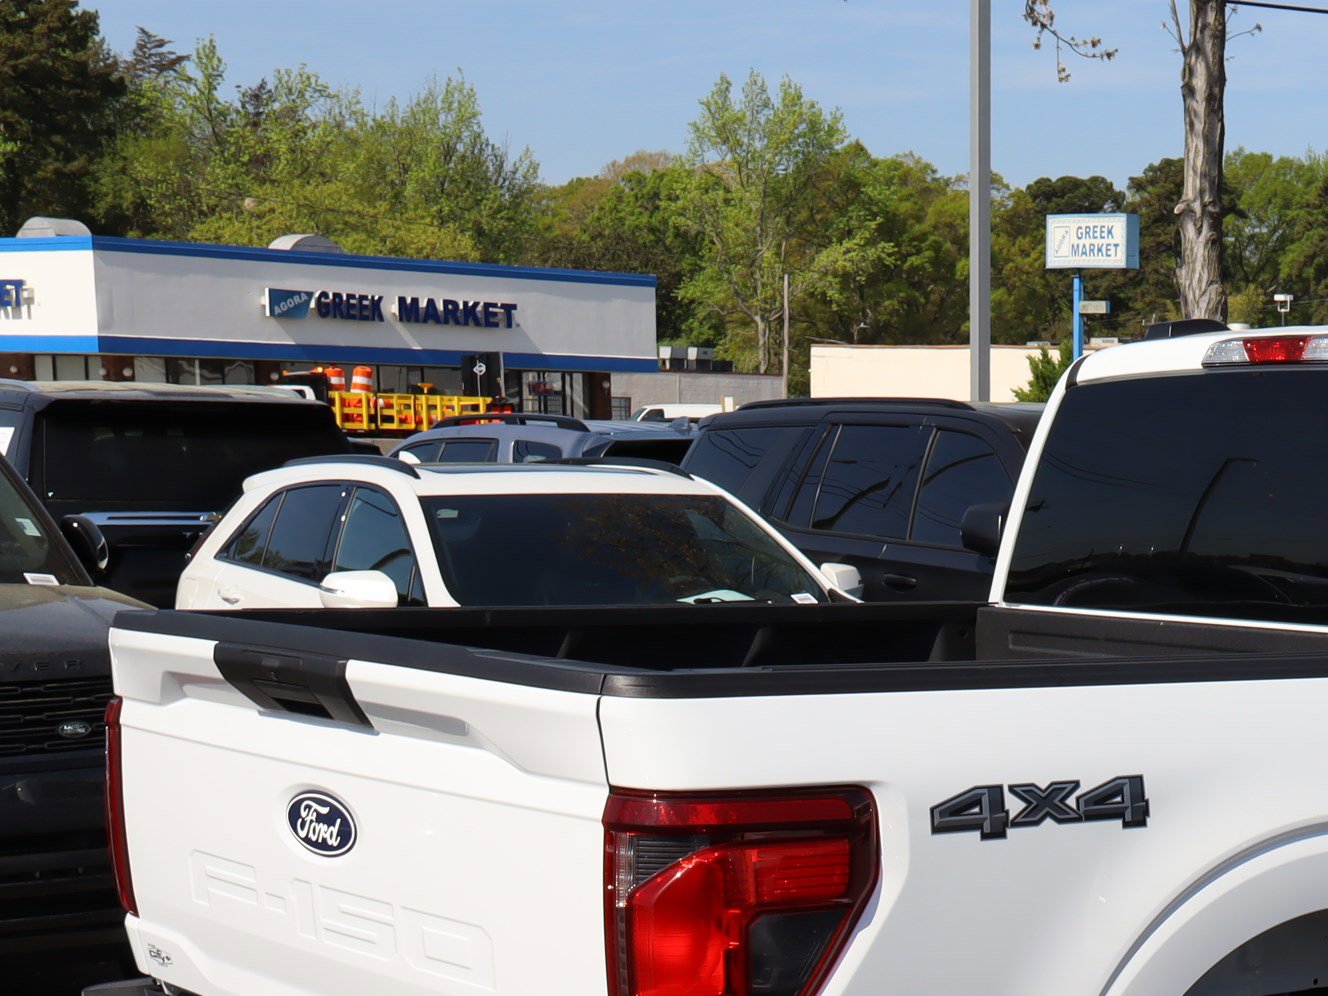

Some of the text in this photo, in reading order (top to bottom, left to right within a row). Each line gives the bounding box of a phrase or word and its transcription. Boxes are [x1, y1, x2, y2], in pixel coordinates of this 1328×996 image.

[1076, 225, 1114, 240] GREEK
[1071, 243, 1120, 258] MARKET
[273, 292, 309, 316] AGORA
[315, 290, 518, 329] GREEK MARKET
[296, 800, 342, 847] Ford
[188, 848, 497, 992] F-150
